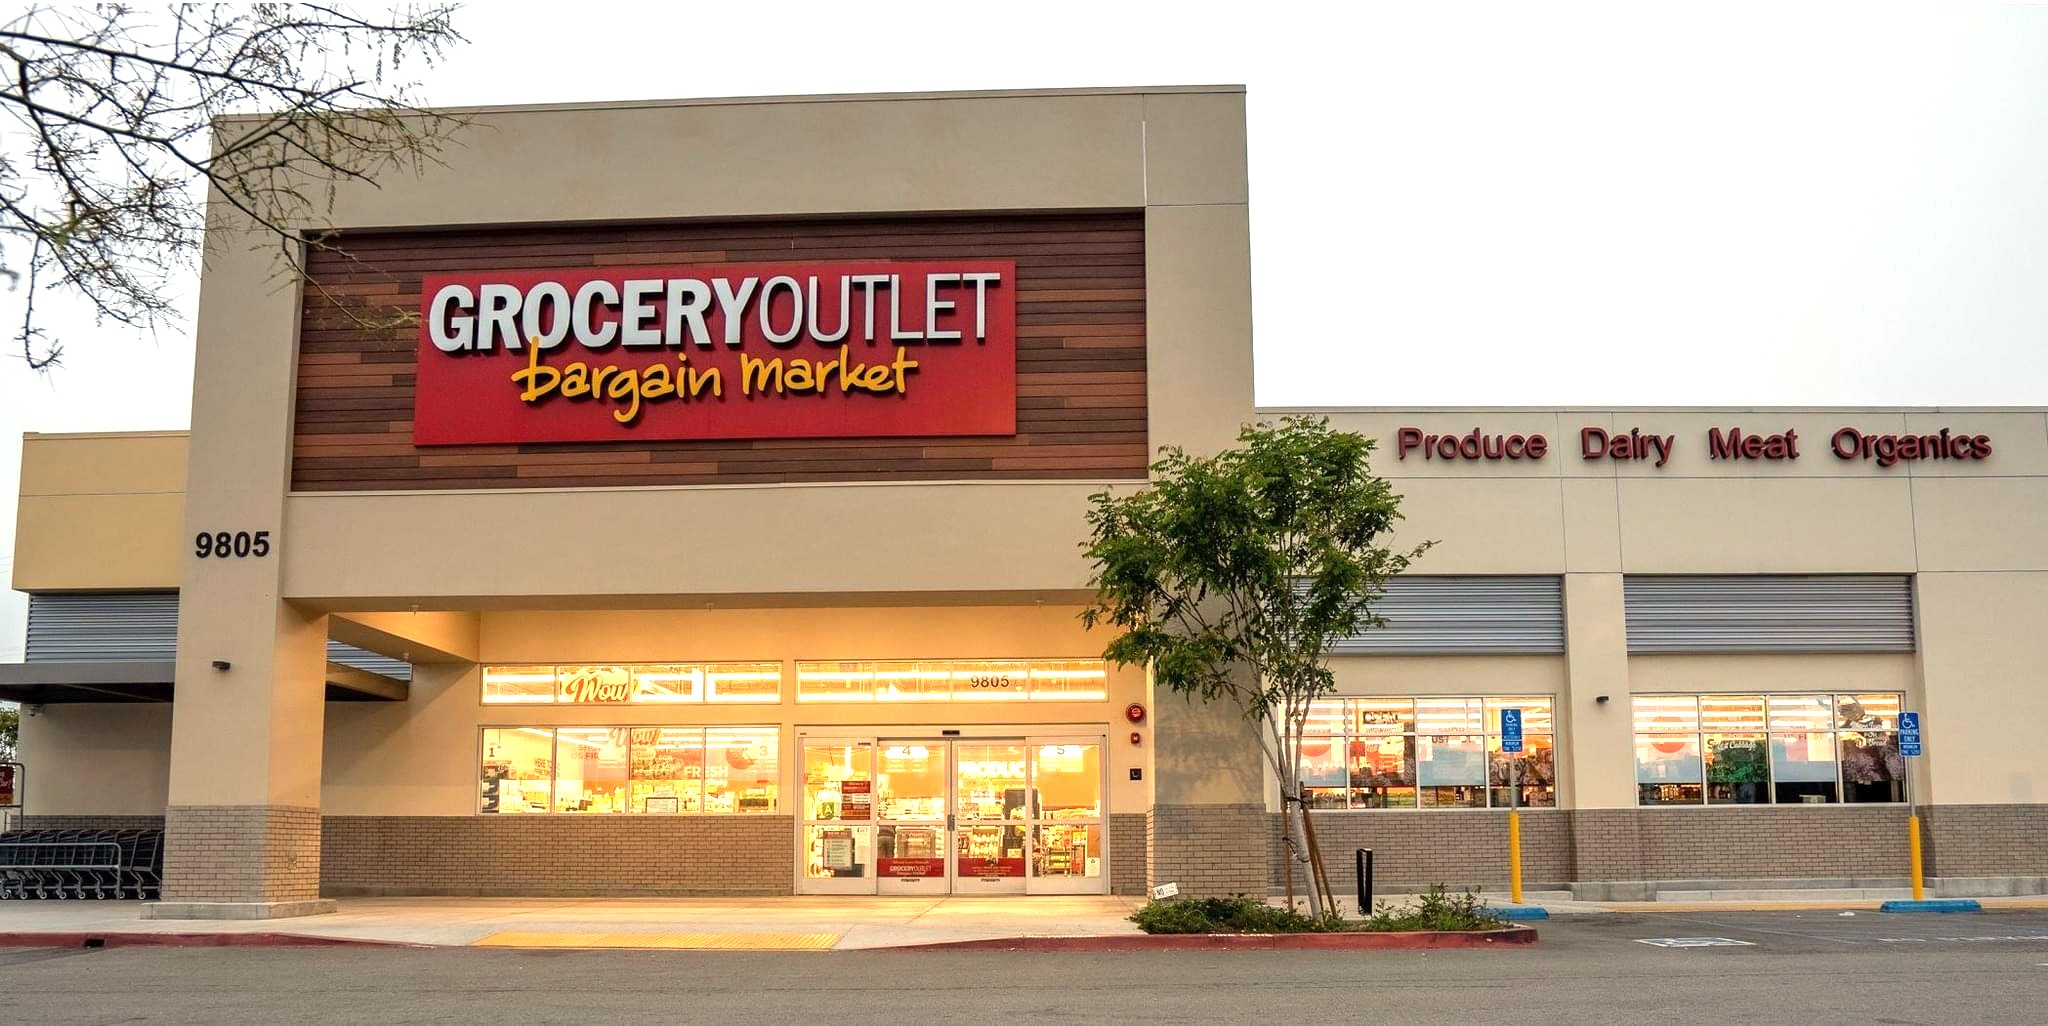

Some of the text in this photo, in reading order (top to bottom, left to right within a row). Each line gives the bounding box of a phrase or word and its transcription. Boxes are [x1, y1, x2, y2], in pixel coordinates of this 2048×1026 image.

[511, 336, 919, 423] bargain market
[1398, 427, 1993, 467] Produce Dairy Meat Organics
[194, 531, 270, 558] 9805
[969, 675, 1010, 688] 9805
